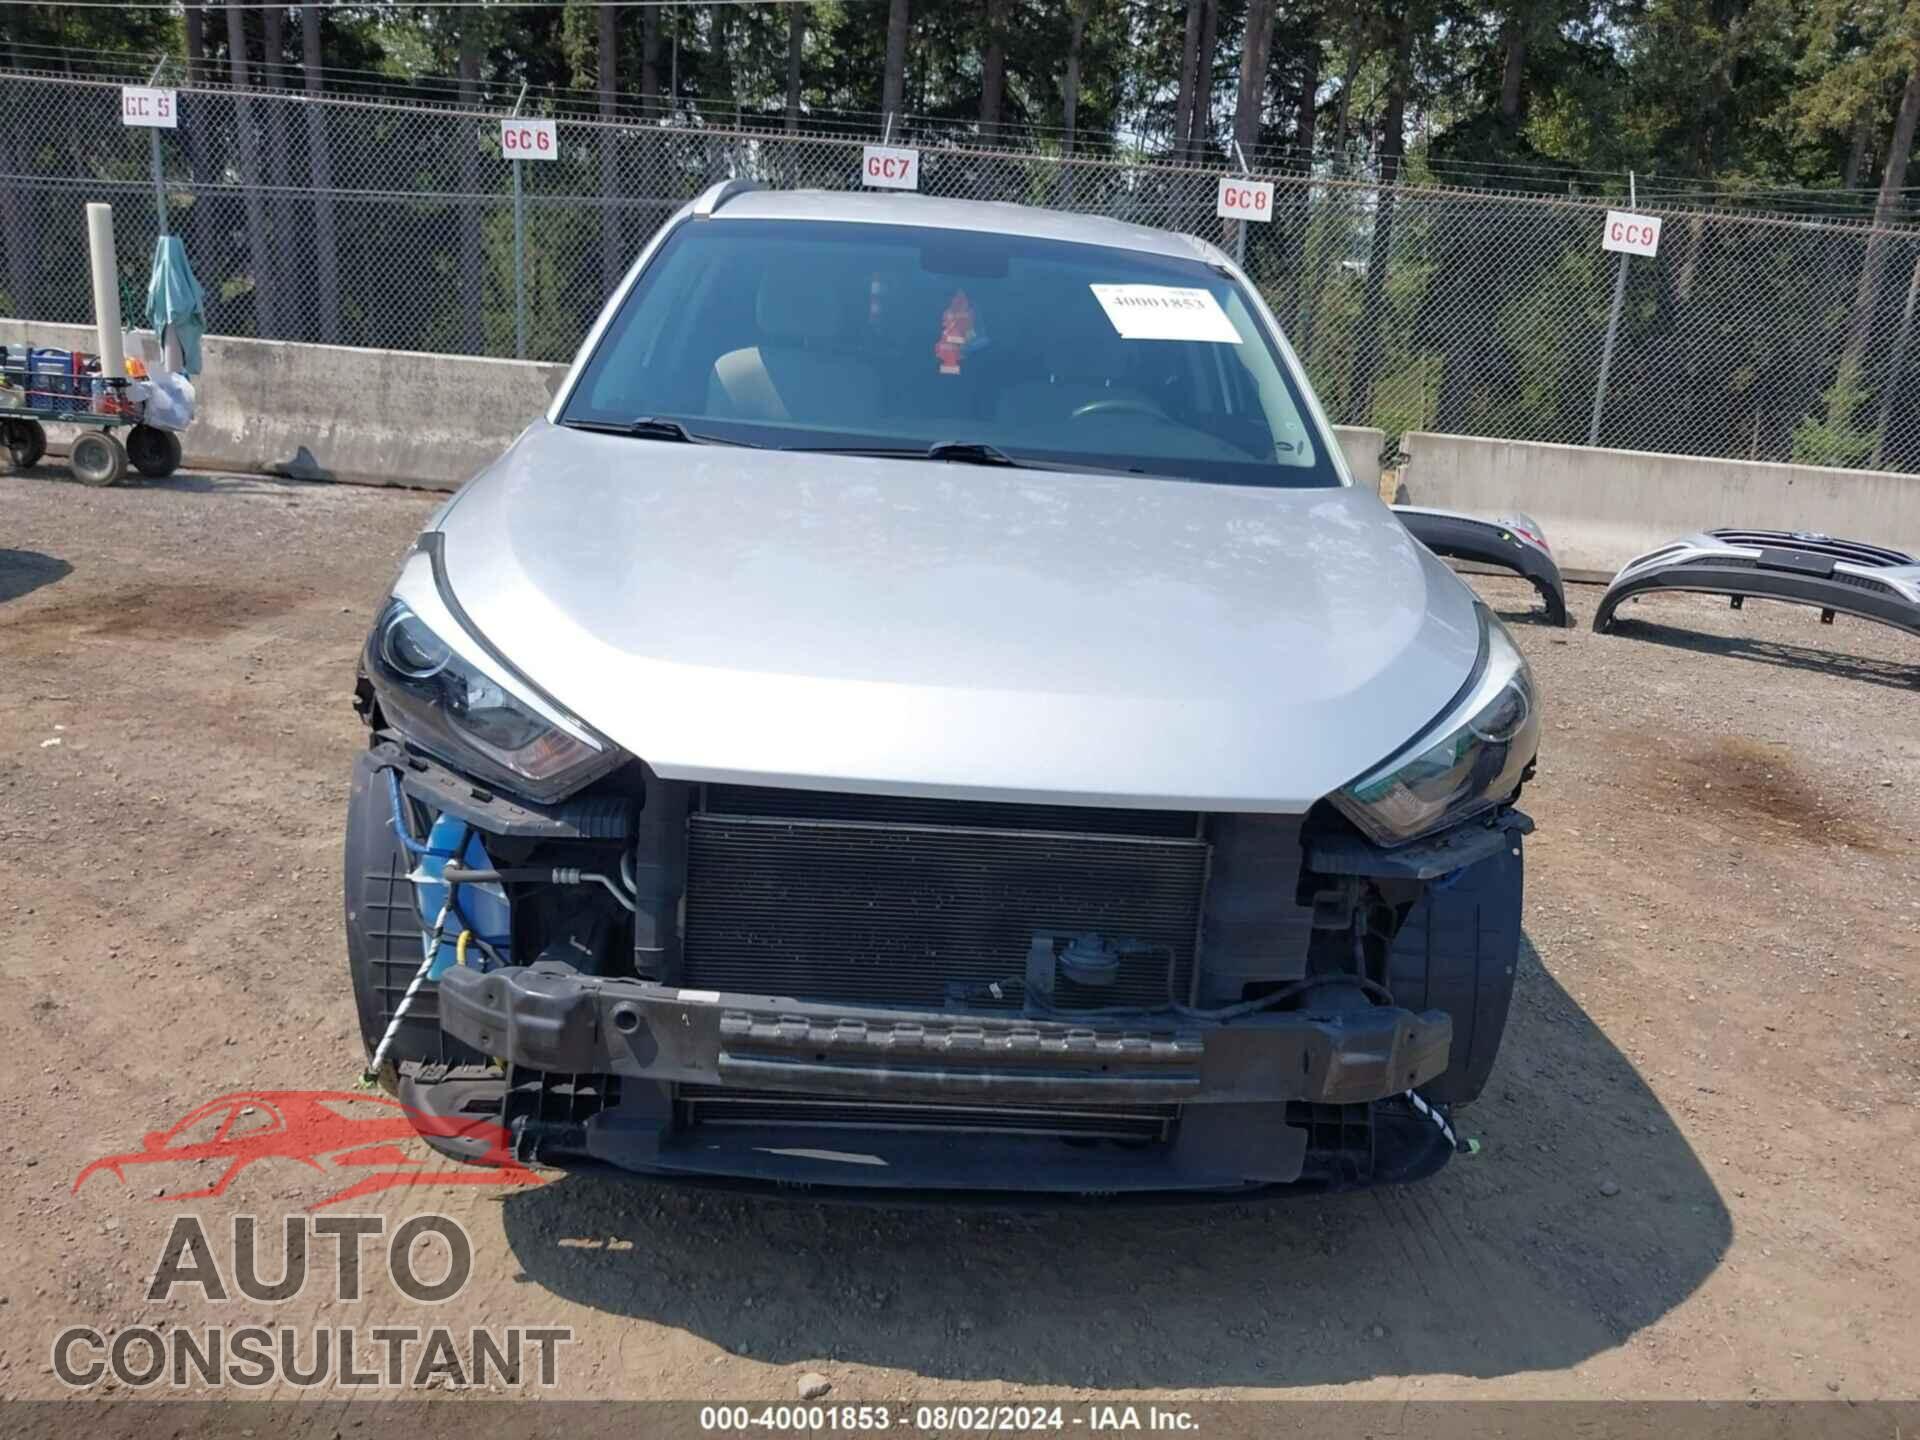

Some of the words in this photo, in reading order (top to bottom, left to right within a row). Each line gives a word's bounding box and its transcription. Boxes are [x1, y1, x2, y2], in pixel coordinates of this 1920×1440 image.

[504, 129, 549, 151] GC6
[868, 156, 910, 179] GC7
[1224, 187, 1267, 210] GC8
[1611, 222, 1654, 246] GC9
